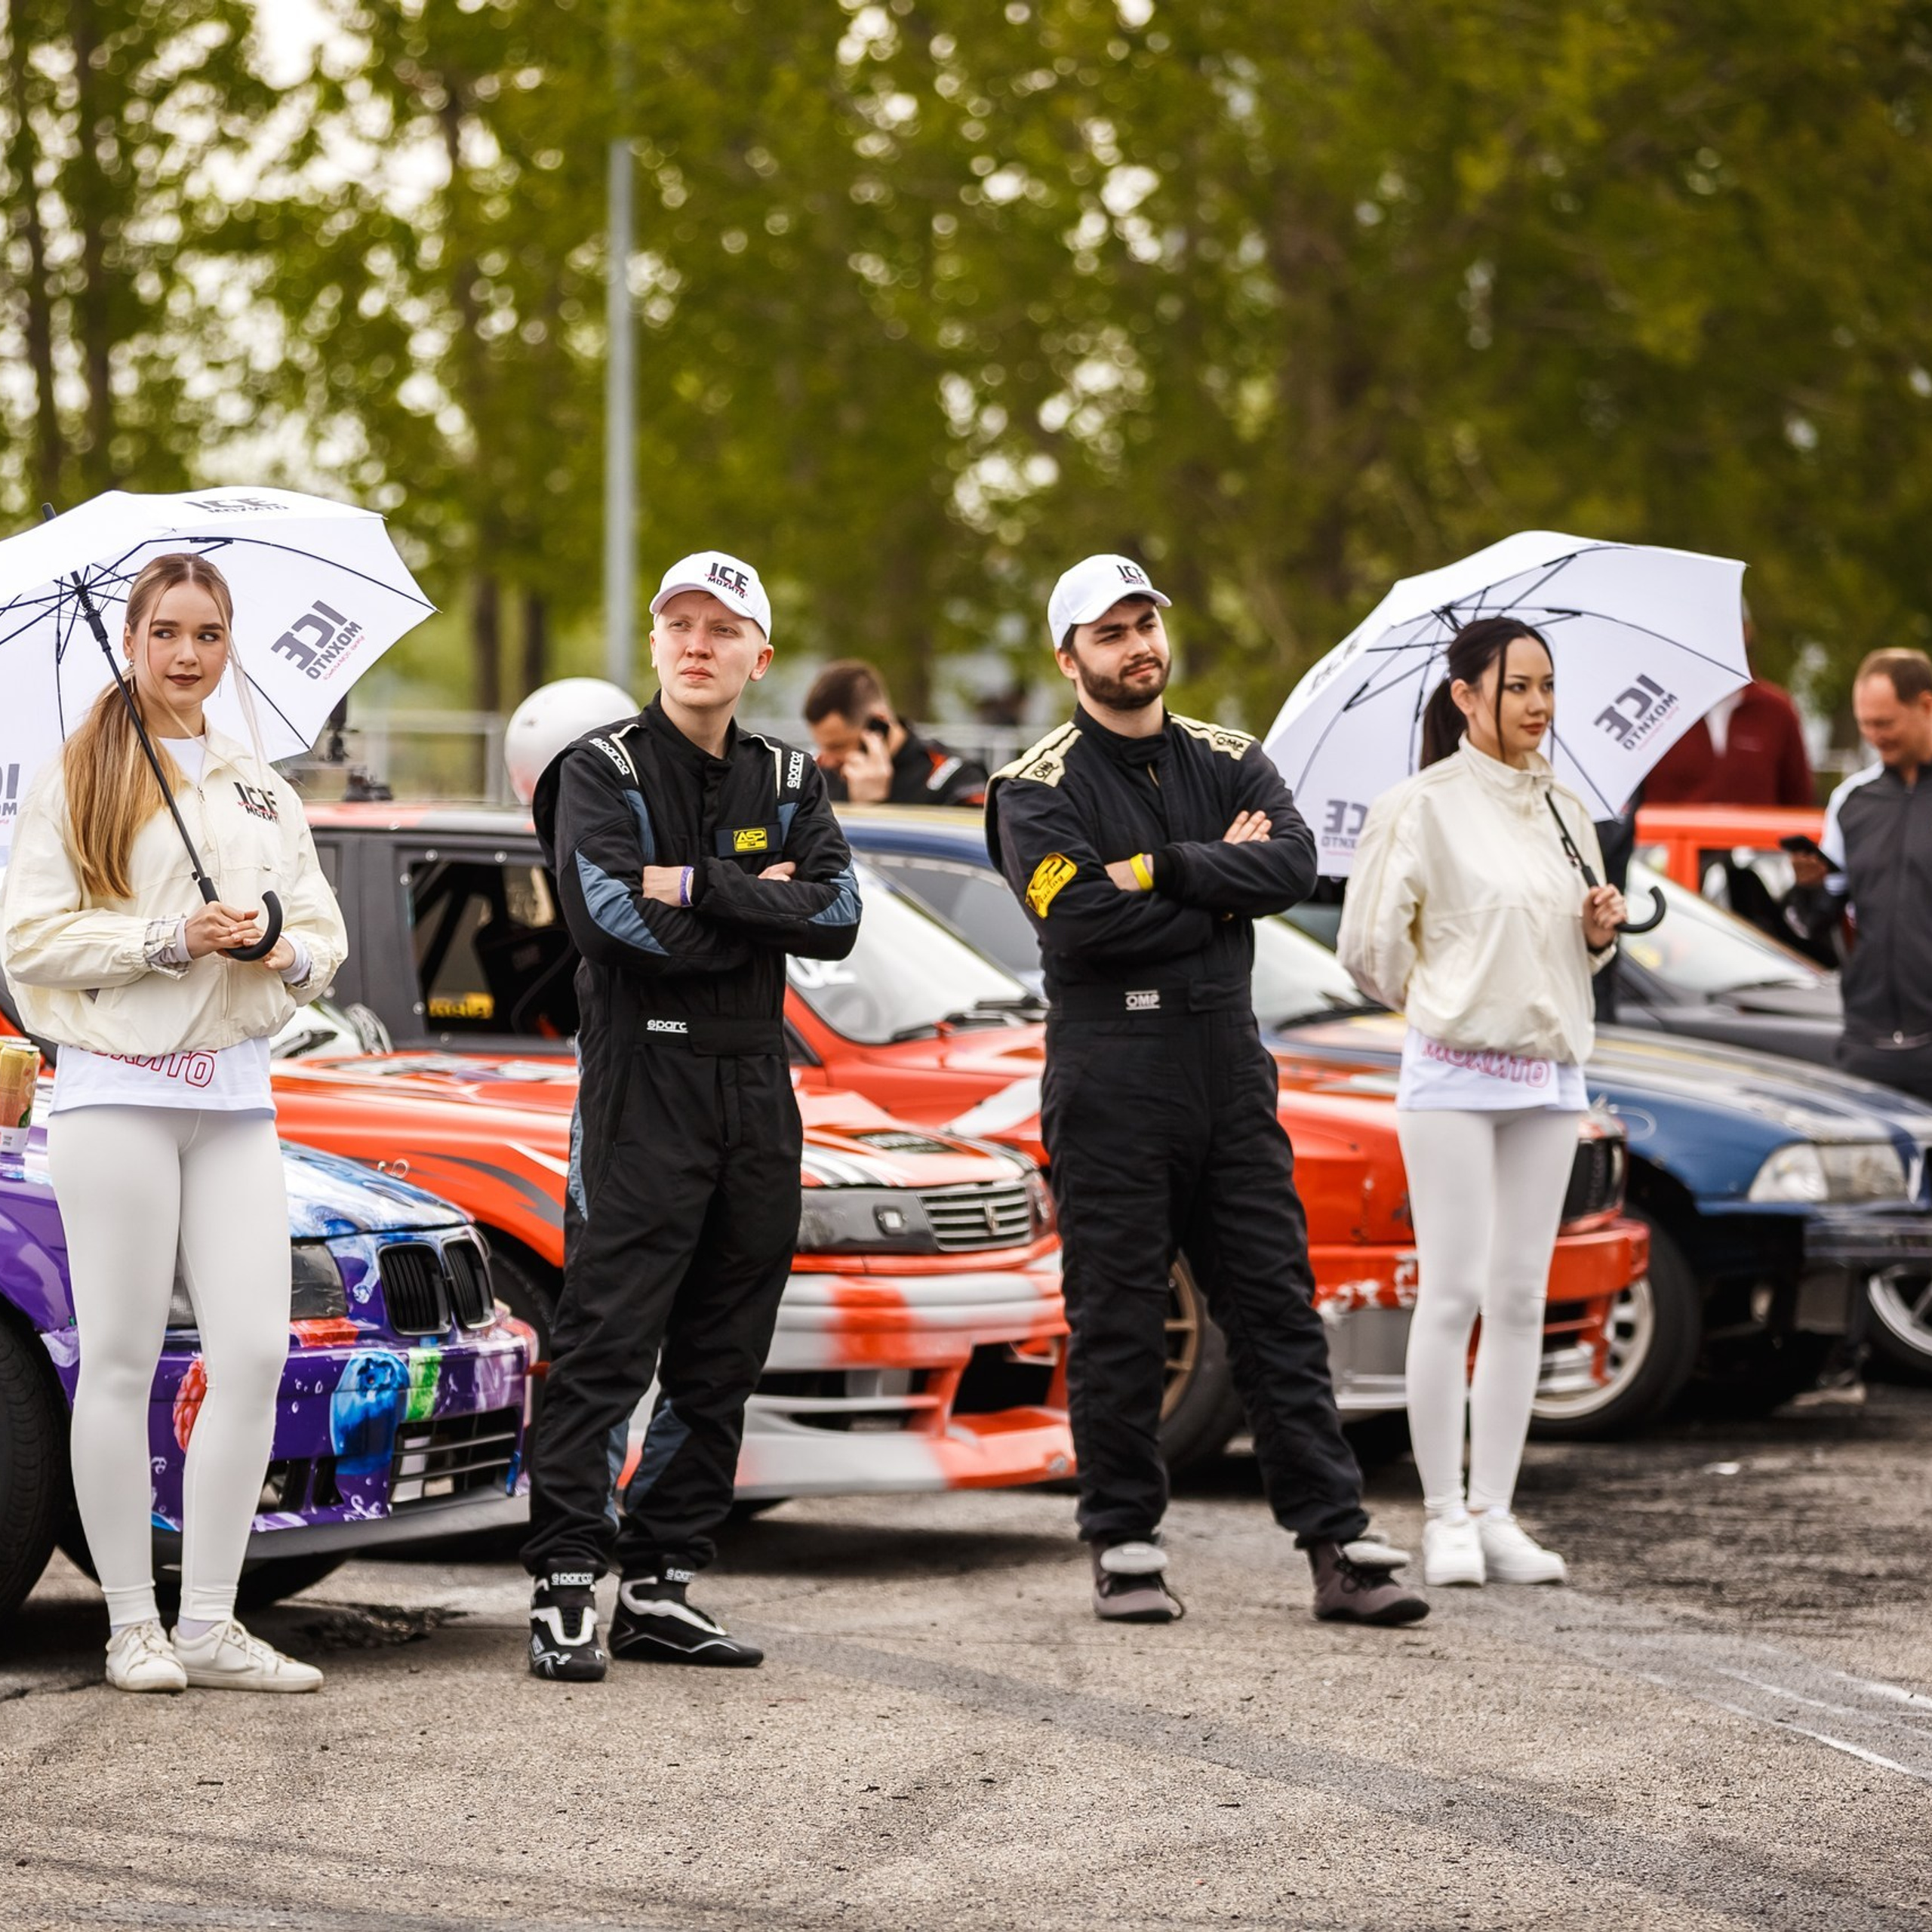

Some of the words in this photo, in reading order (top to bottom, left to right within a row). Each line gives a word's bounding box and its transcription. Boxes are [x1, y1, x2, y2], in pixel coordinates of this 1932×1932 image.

[707, 576, 745, 598] МОХИТО
[709, 562, 749, 593] ICE
[589, 737, 630, 775] sparco
[786, 751, 804, 789] sparco
[233, 782, 278, 816] ICE
[737, 830, 765, 843] ASP
[1125, 992, 1160, 1008] OMP
[552, 1572, 594, 1585] sparco
